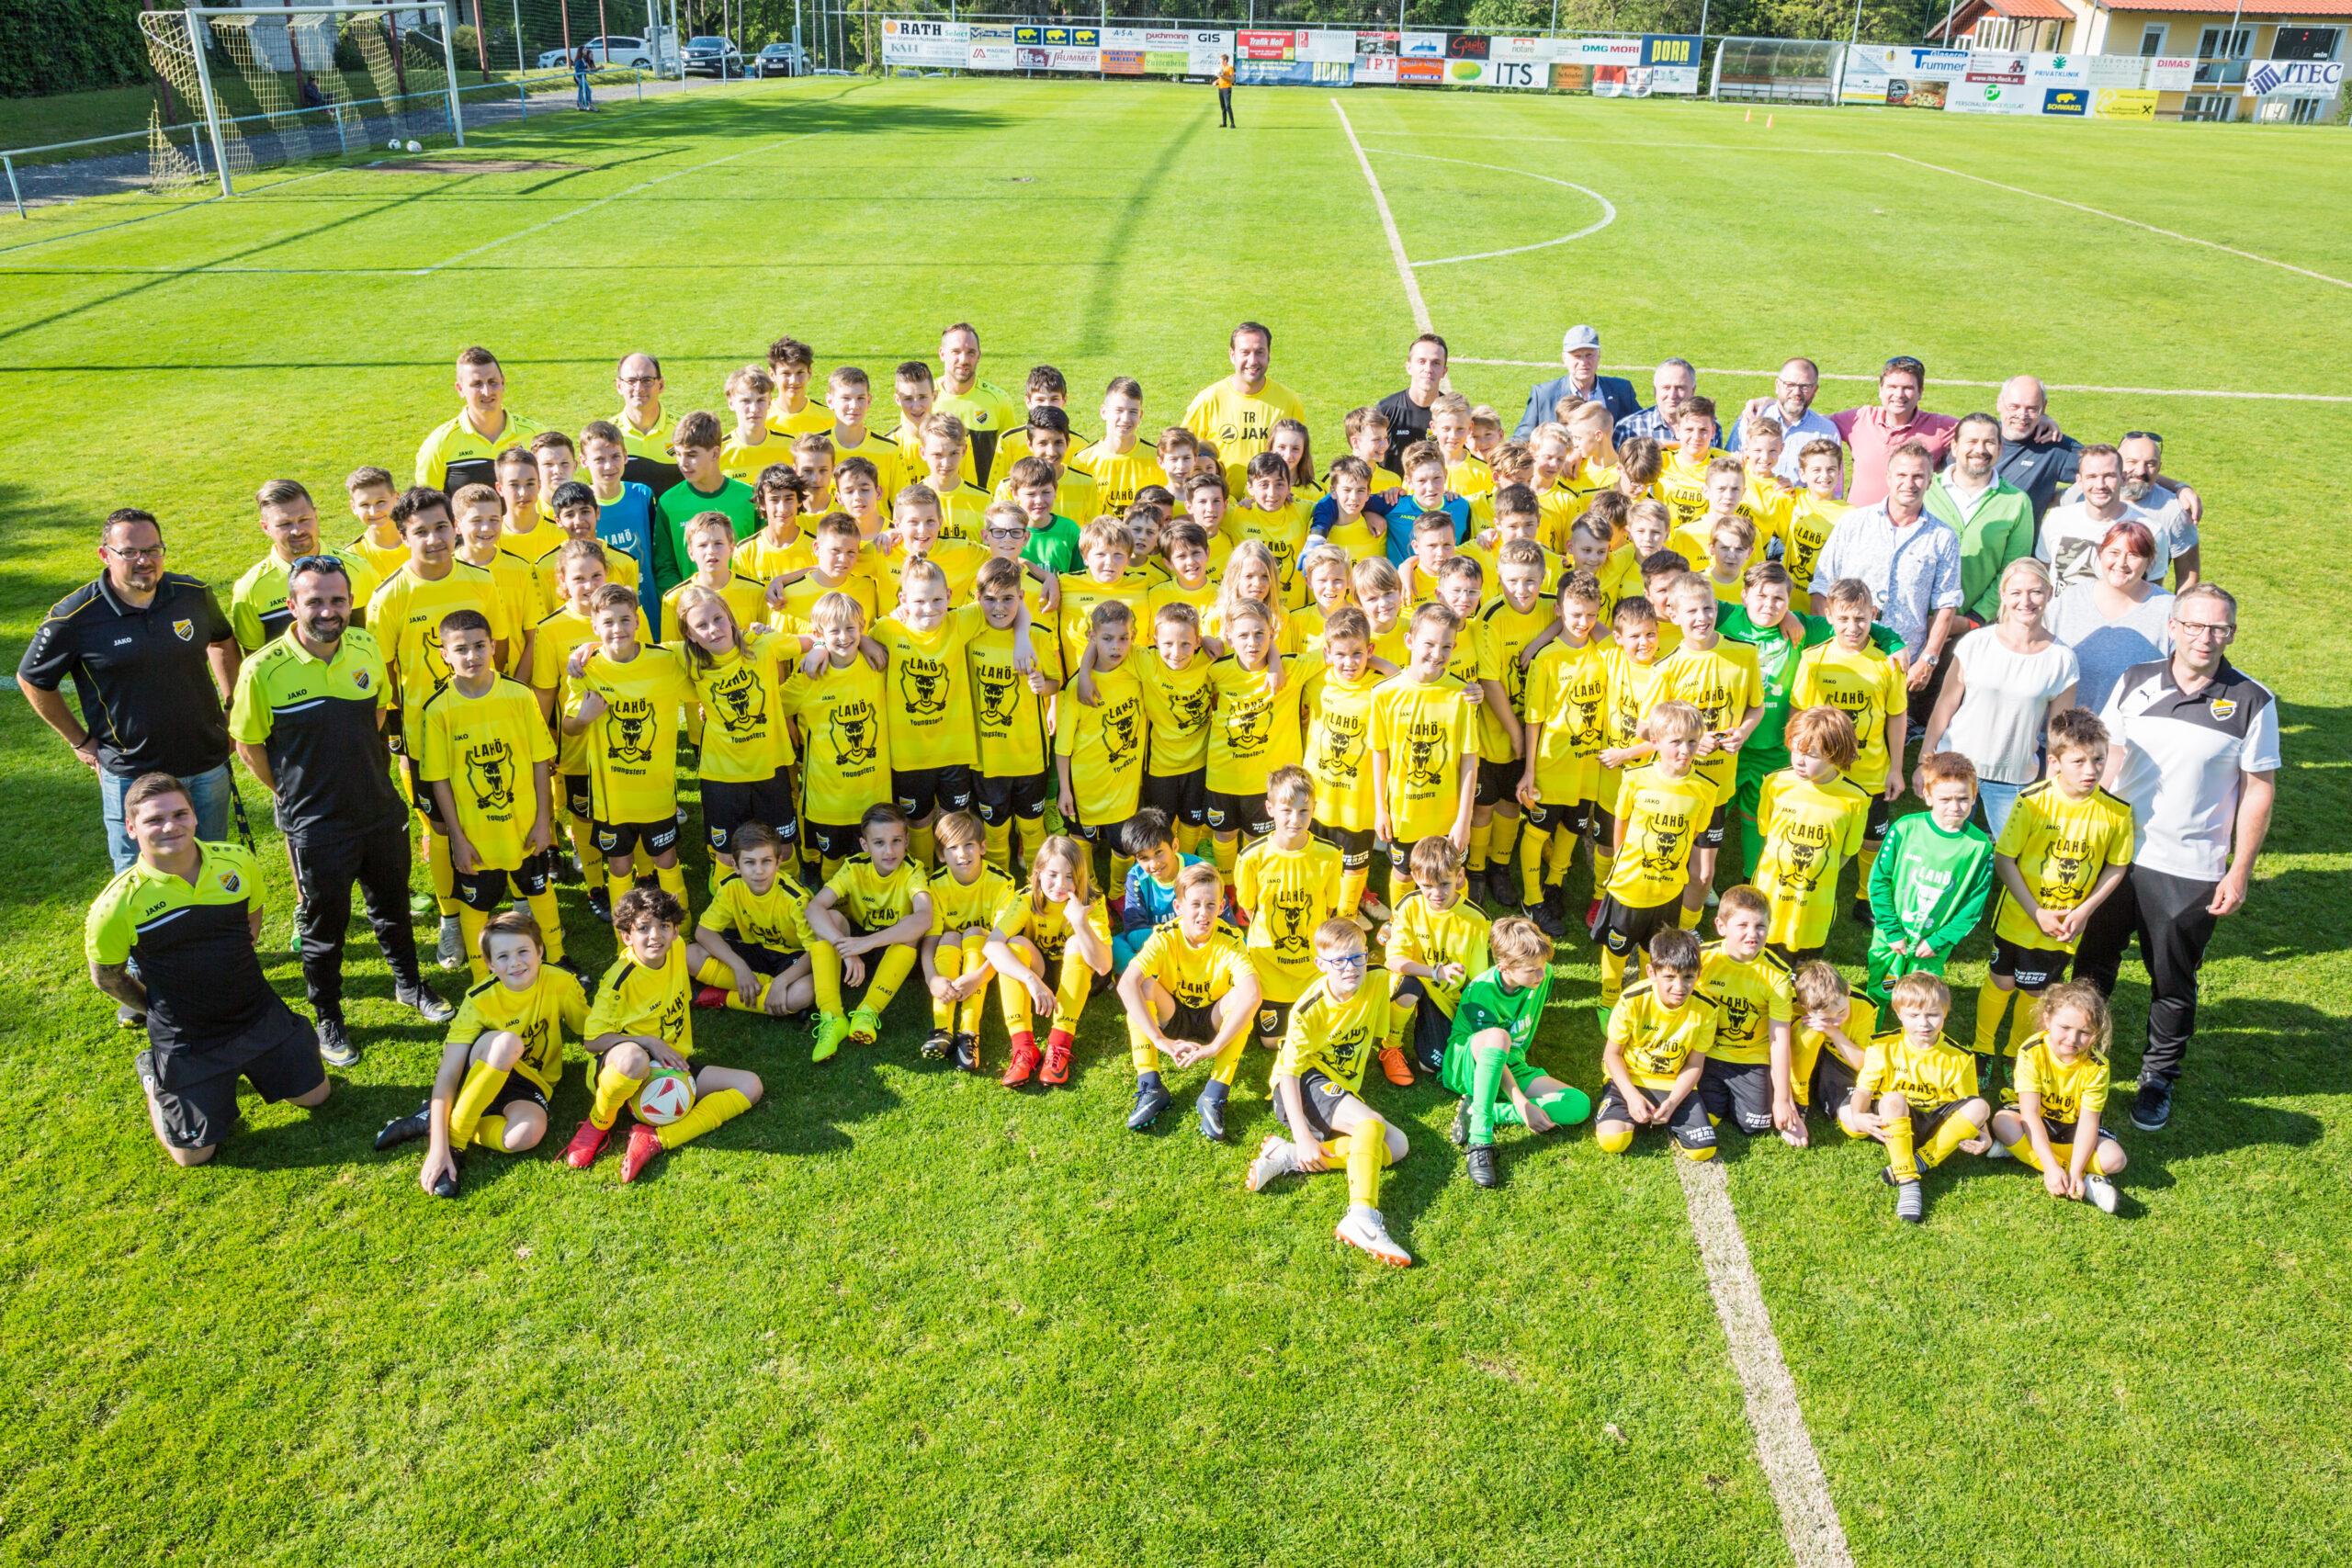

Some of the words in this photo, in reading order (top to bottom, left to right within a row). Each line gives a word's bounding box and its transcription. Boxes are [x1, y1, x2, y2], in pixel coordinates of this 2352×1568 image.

[900, 23, 942, 36] RATH
[944, 29, 967, 38] Select
[1146, 32, 1189, 40] puchmann
[1197, 33, 1220, 43] GIS
[1250, 37, 1269, 46] Trafik
[2157, 59, 2190, 68] DIMAS
[2034, 70, 2079, 78] PRIVATKLINIK
[2283, 63, 2342, 85] ITEC
[2046, 103, 2082, 111] SCHWARZL
[1243, 412, 1255, 423] TR
[1241, 427, 1268, 440] JAK
[1671, 490, 1702, 502] LAHÖ
[1796, 525, 1824, 546] LAHÖ
[269, 596, 288, 607] JAKO
[409, 615, 427, 624] JAKO
[114, 637, 132, 647] JAKO
[909, 657, 938, 672] LAHÖ
[718, 666, 748, 691] LAHÖ
[980, 665, 1012, 680] LAHÖ
[288, 689, 308, 700] JAKO
[1574, 679, 1602, 696] LAHÖ
[1698, 685, 1724, 704] LAHÖ
[1833, 690, 1864, 705] LAHÖ
[614, 698, 649, 714] LAHÖ
[837, 698, 867, 717] LAHÖ
[1329, 712, 1359, 729] LAHÖ
[1409, 721, 1439, 735] LAHÖ
[473, 739, 503, 759] LAHÖ
[1574, 748, 1600, 760] Youngster
[1654, 812, 1684, 828] LAHÖ
[1791, 820, 1825, 840] LAHÖ
[2055, 839, 2086, 852] LAHÖ
[1918, 867, 1953, 884] LAHÖ
[1279, 888, 1306, 902] LAHÖ
[145, 900, 166, 917] JAKO
[1180, 979, 1211, 994] LAHÖ
[505, 1019, 520, 1027] JAKO
[1648, 1039, 1679, 1053] LAHÖ
